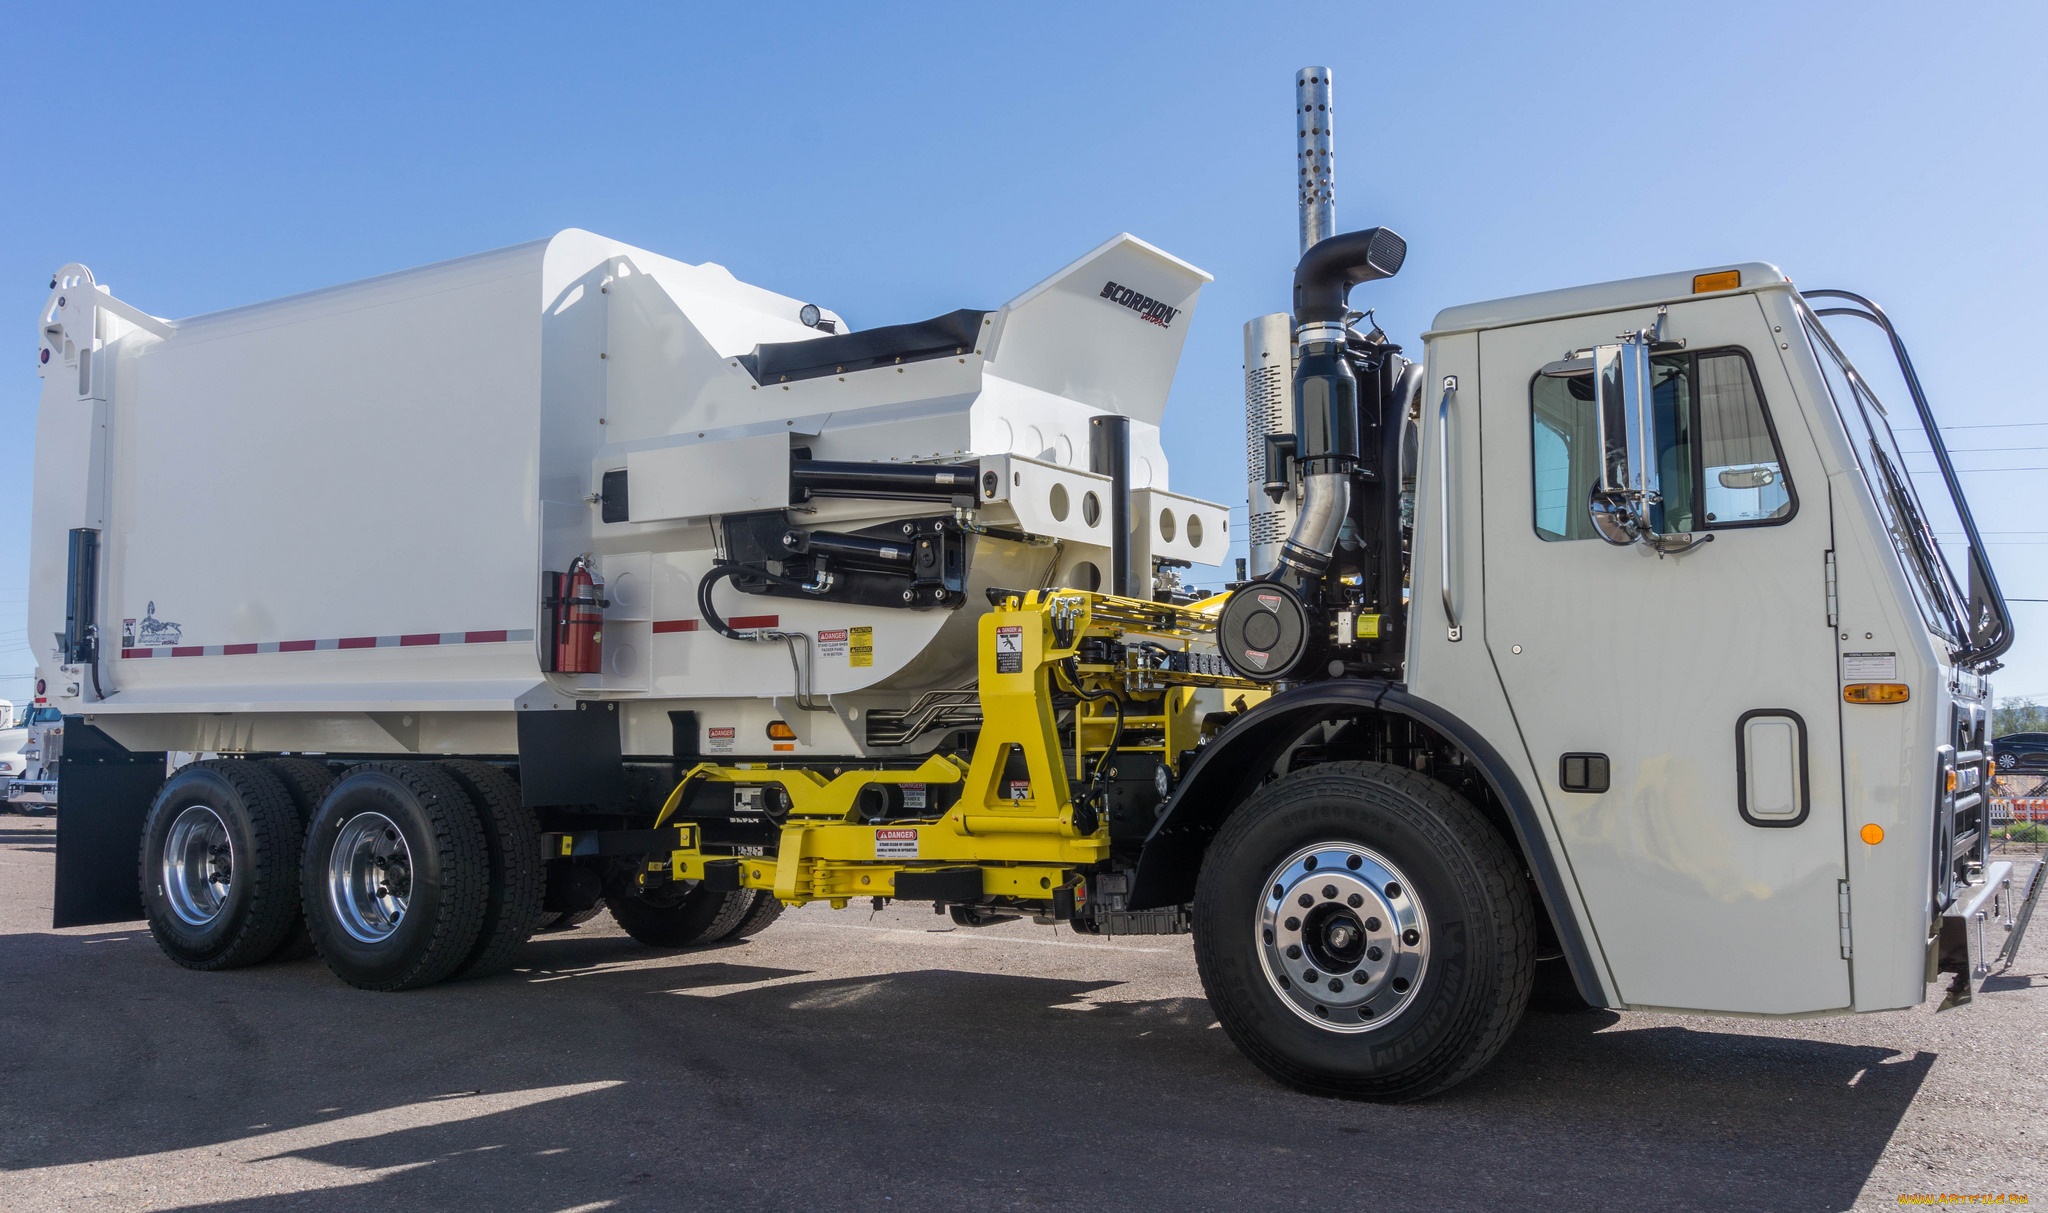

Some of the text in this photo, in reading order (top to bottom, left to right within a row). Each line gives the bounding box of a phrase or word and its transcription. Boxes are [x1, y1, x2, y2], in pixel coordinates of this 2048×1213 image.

[1100, 281, 1178, 324] SCORPION
[824, 632, 846, 640] DANGER
[1375, 961, 1464, 1069] MICHELIN
